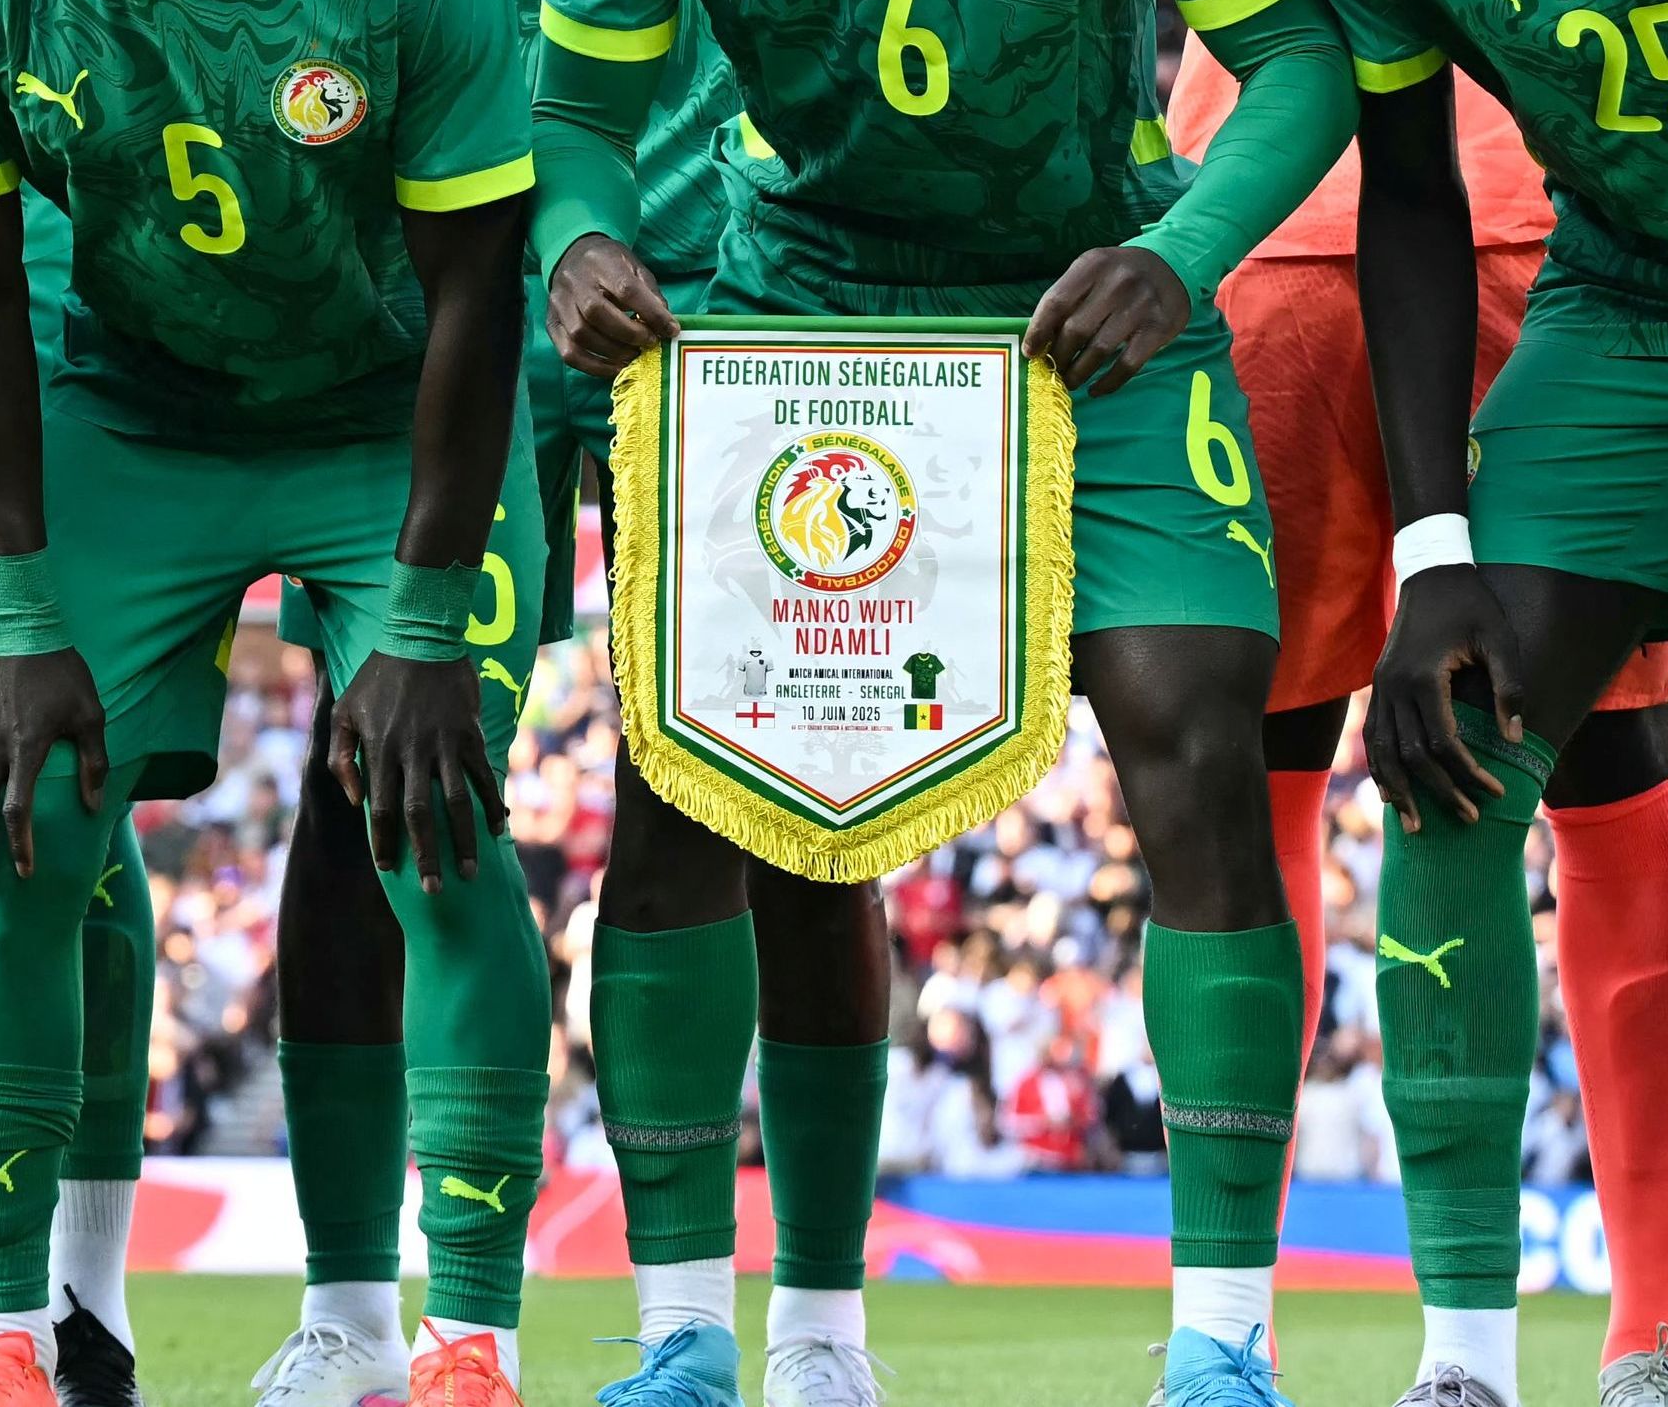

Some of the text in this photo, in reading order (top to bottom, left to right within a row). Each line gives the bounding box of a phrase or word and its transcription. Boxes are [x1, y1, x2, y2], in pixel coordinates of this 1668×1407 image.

[162, 122, 246, 255] 5
[702, 356, 982, 388] FÉDÉRATION SÉNÉGALAISE
[774, 399, 914, 426] DE FOOTBALL
[1186, 370, 1252, 507] 6
[758, 434, 910, 588] FÉDÉRATION SÉNÉGALAISE DE FOOTBALL
[772, 598, 913, 624] MANKO WUTI
[795, 627, 890, 656] NDAMLI
[789, 668, 894, 680] MATCH AMICAL INTERNATIONAL
[775, 684, 841, 698] ANGLETERRE
[860, 685, 906, 699] SENEGAL
[802, 705, 881, 721] 10 JUIN 2025
